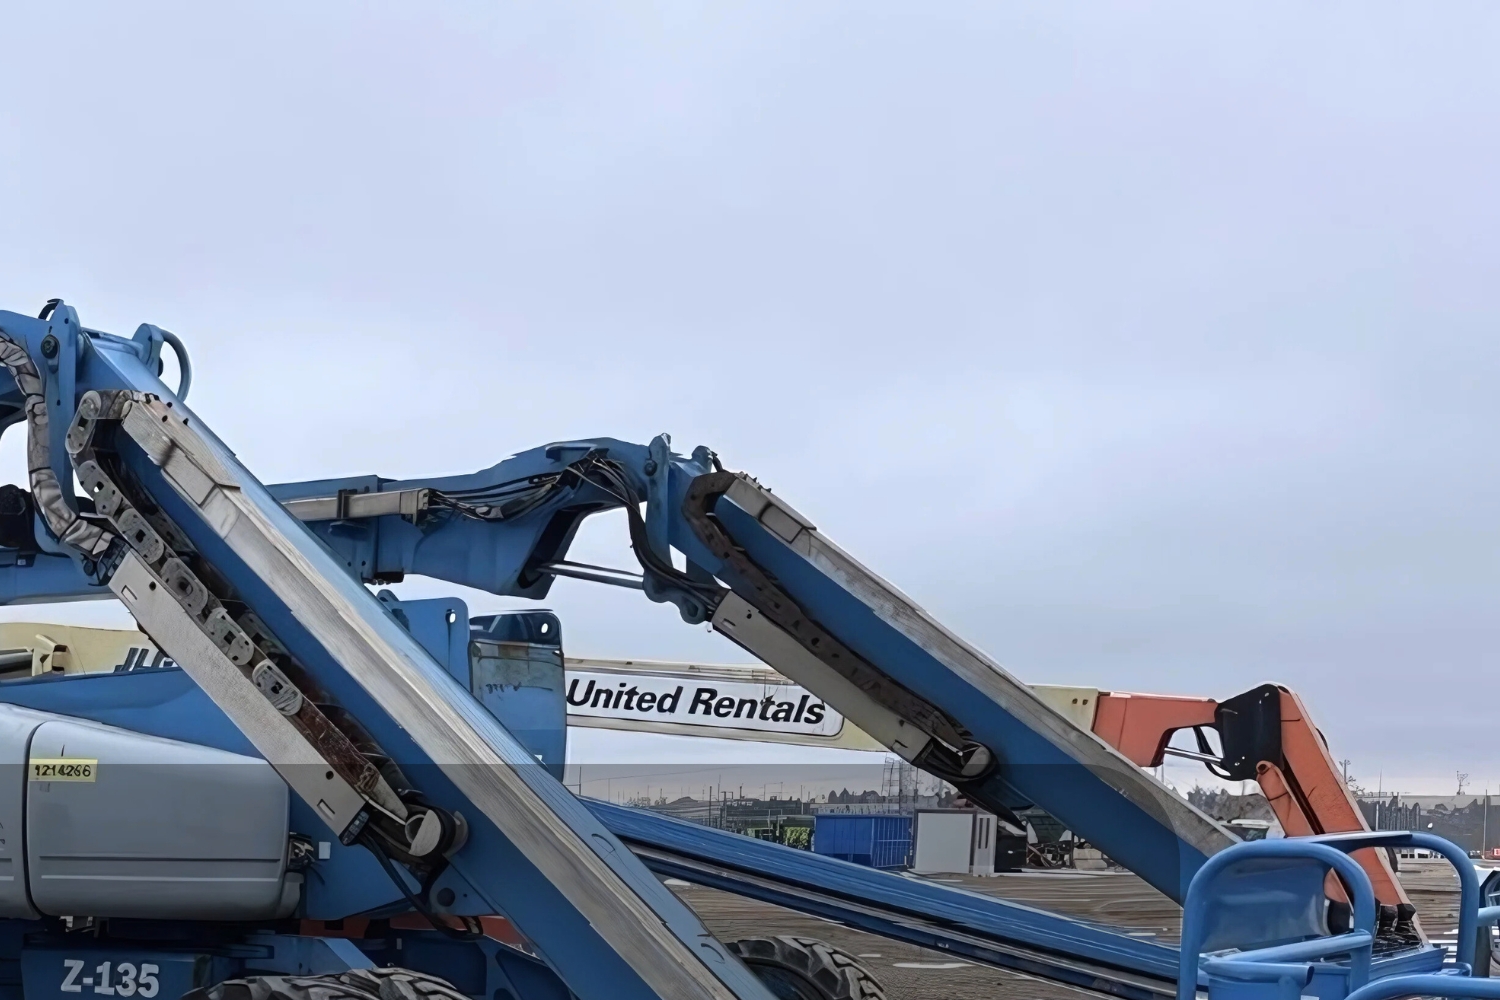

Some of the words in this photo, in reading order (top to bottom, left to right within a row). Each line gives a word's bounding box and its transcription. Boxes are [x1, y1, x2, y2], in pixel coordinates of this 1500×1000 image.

[566, 678, 684, 715] United
[687, 687, 826, 725] Rentals
[60, 958, 160, 999] Z-135
